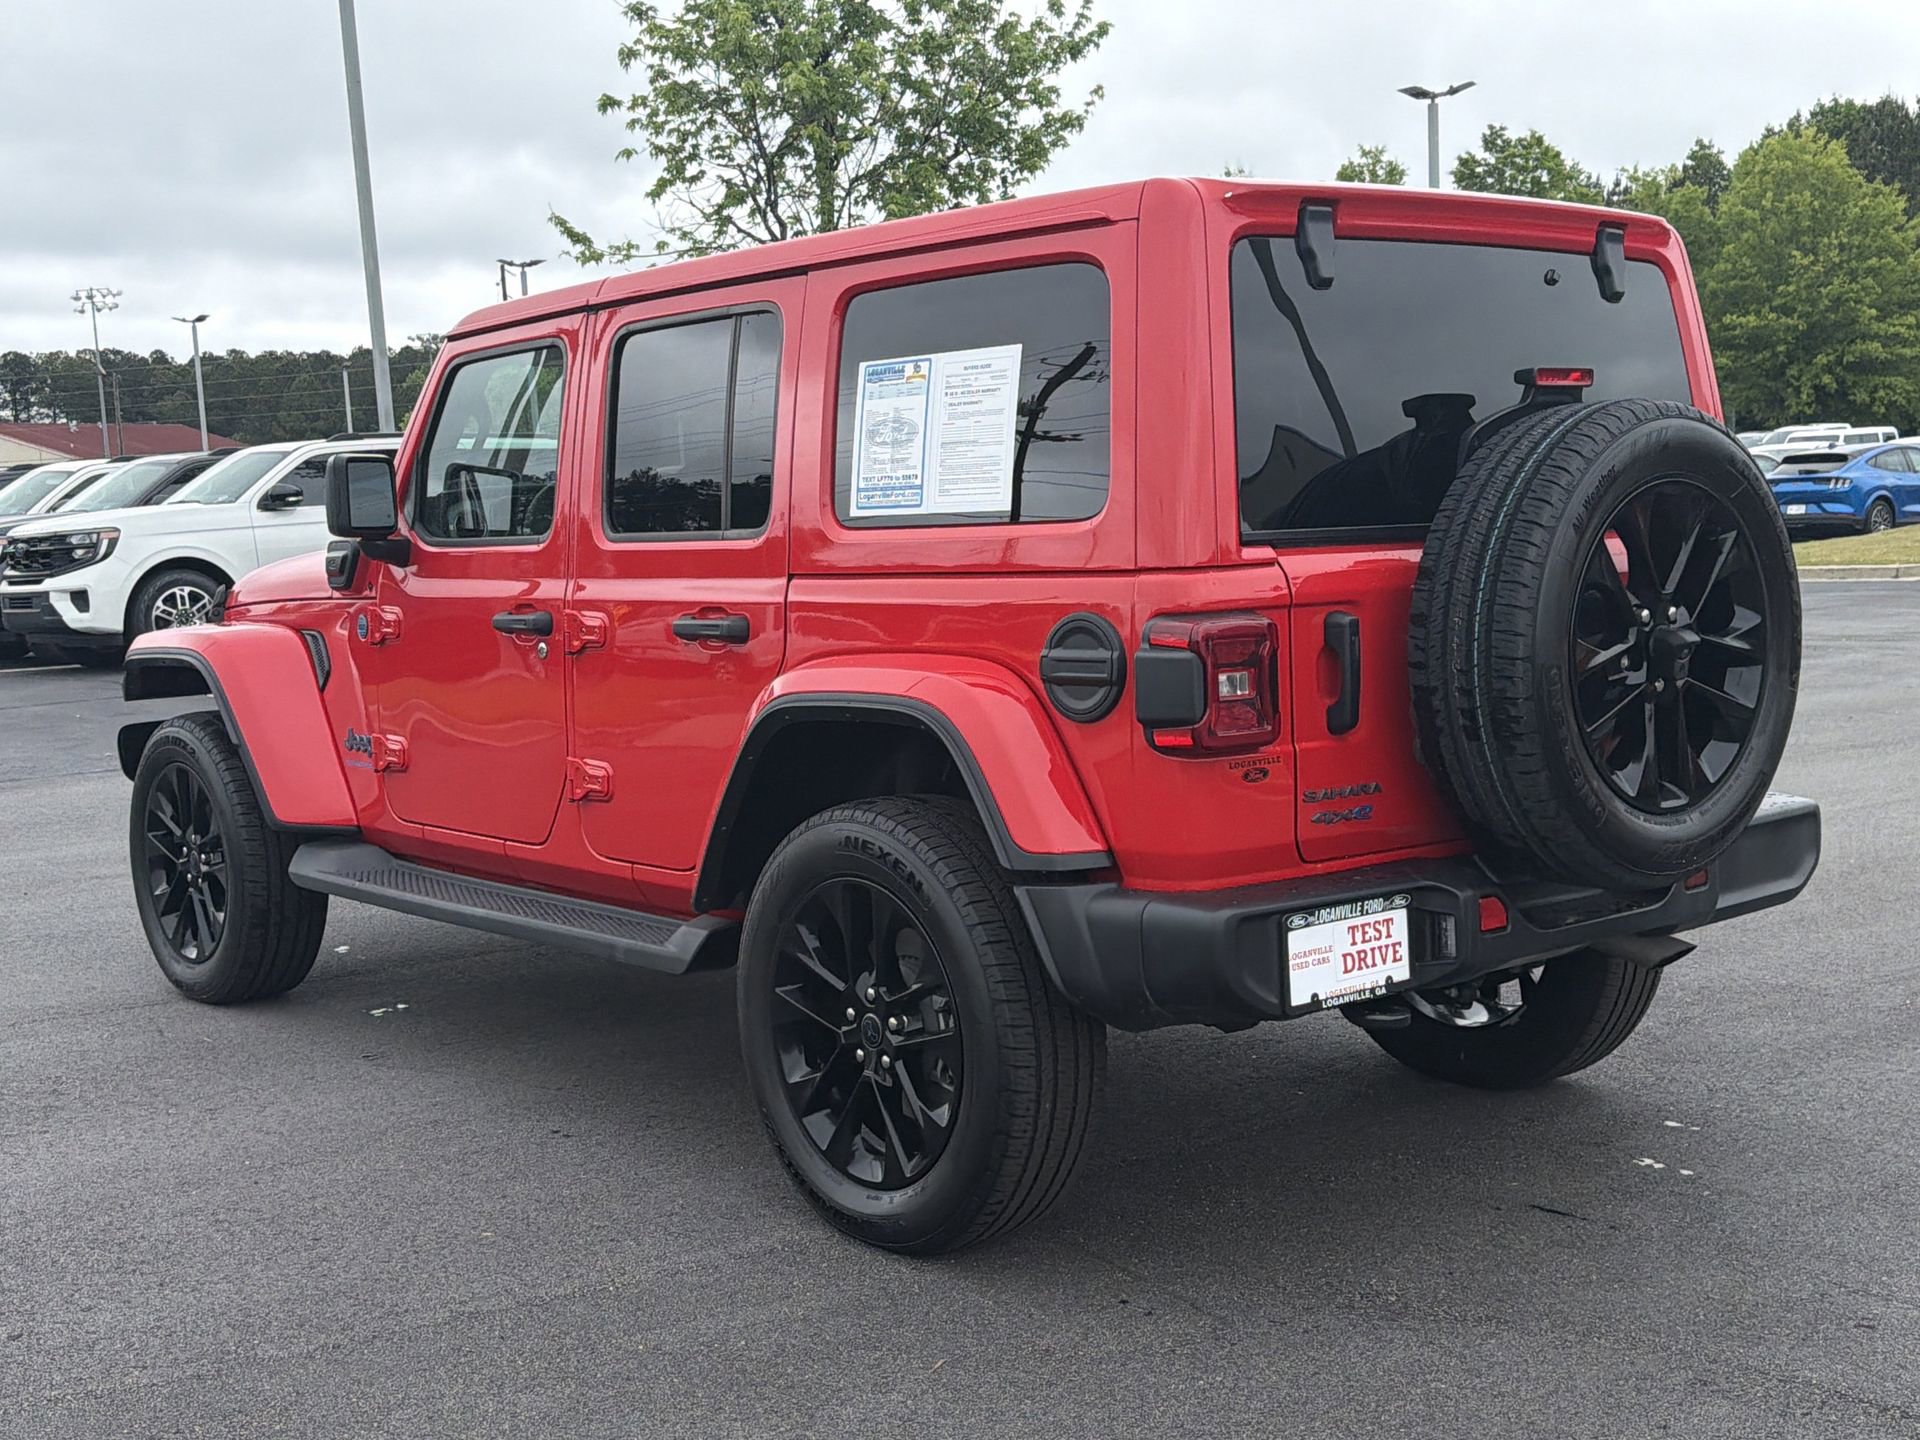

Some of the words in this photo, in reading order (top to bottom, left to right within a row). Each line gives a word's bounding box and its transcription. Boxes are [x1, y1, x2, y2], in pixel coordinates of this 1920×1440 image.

[867, 365, 906, 377] LOGANVILLE
[859, 491, 921, 501] LoganvilleFord.com
[344, 726, 373, 759] Jeep
[1229, 756, 1281, 770] LOGANVILLE
[1302, 782, 1382, 803] SAHARA
[843, 835, 924, 894] NEXEN
[1315, 902, 1362, 924] LOGANVILLE
[1363, 898, 1384, 915] FORD
[1347, 917, 1394, 947] TEST
[1291, 945, 1334, 961] OGANVILLE
[1291, 960, 1310, 971] USED
[1311, 956, 1331, 967] CARS
[1341, 941, 1403, 975] DRIVE
[1322, 989, 1374, 1009] LOGANVILLE,
[1375, 986, 1387, 996] GA
